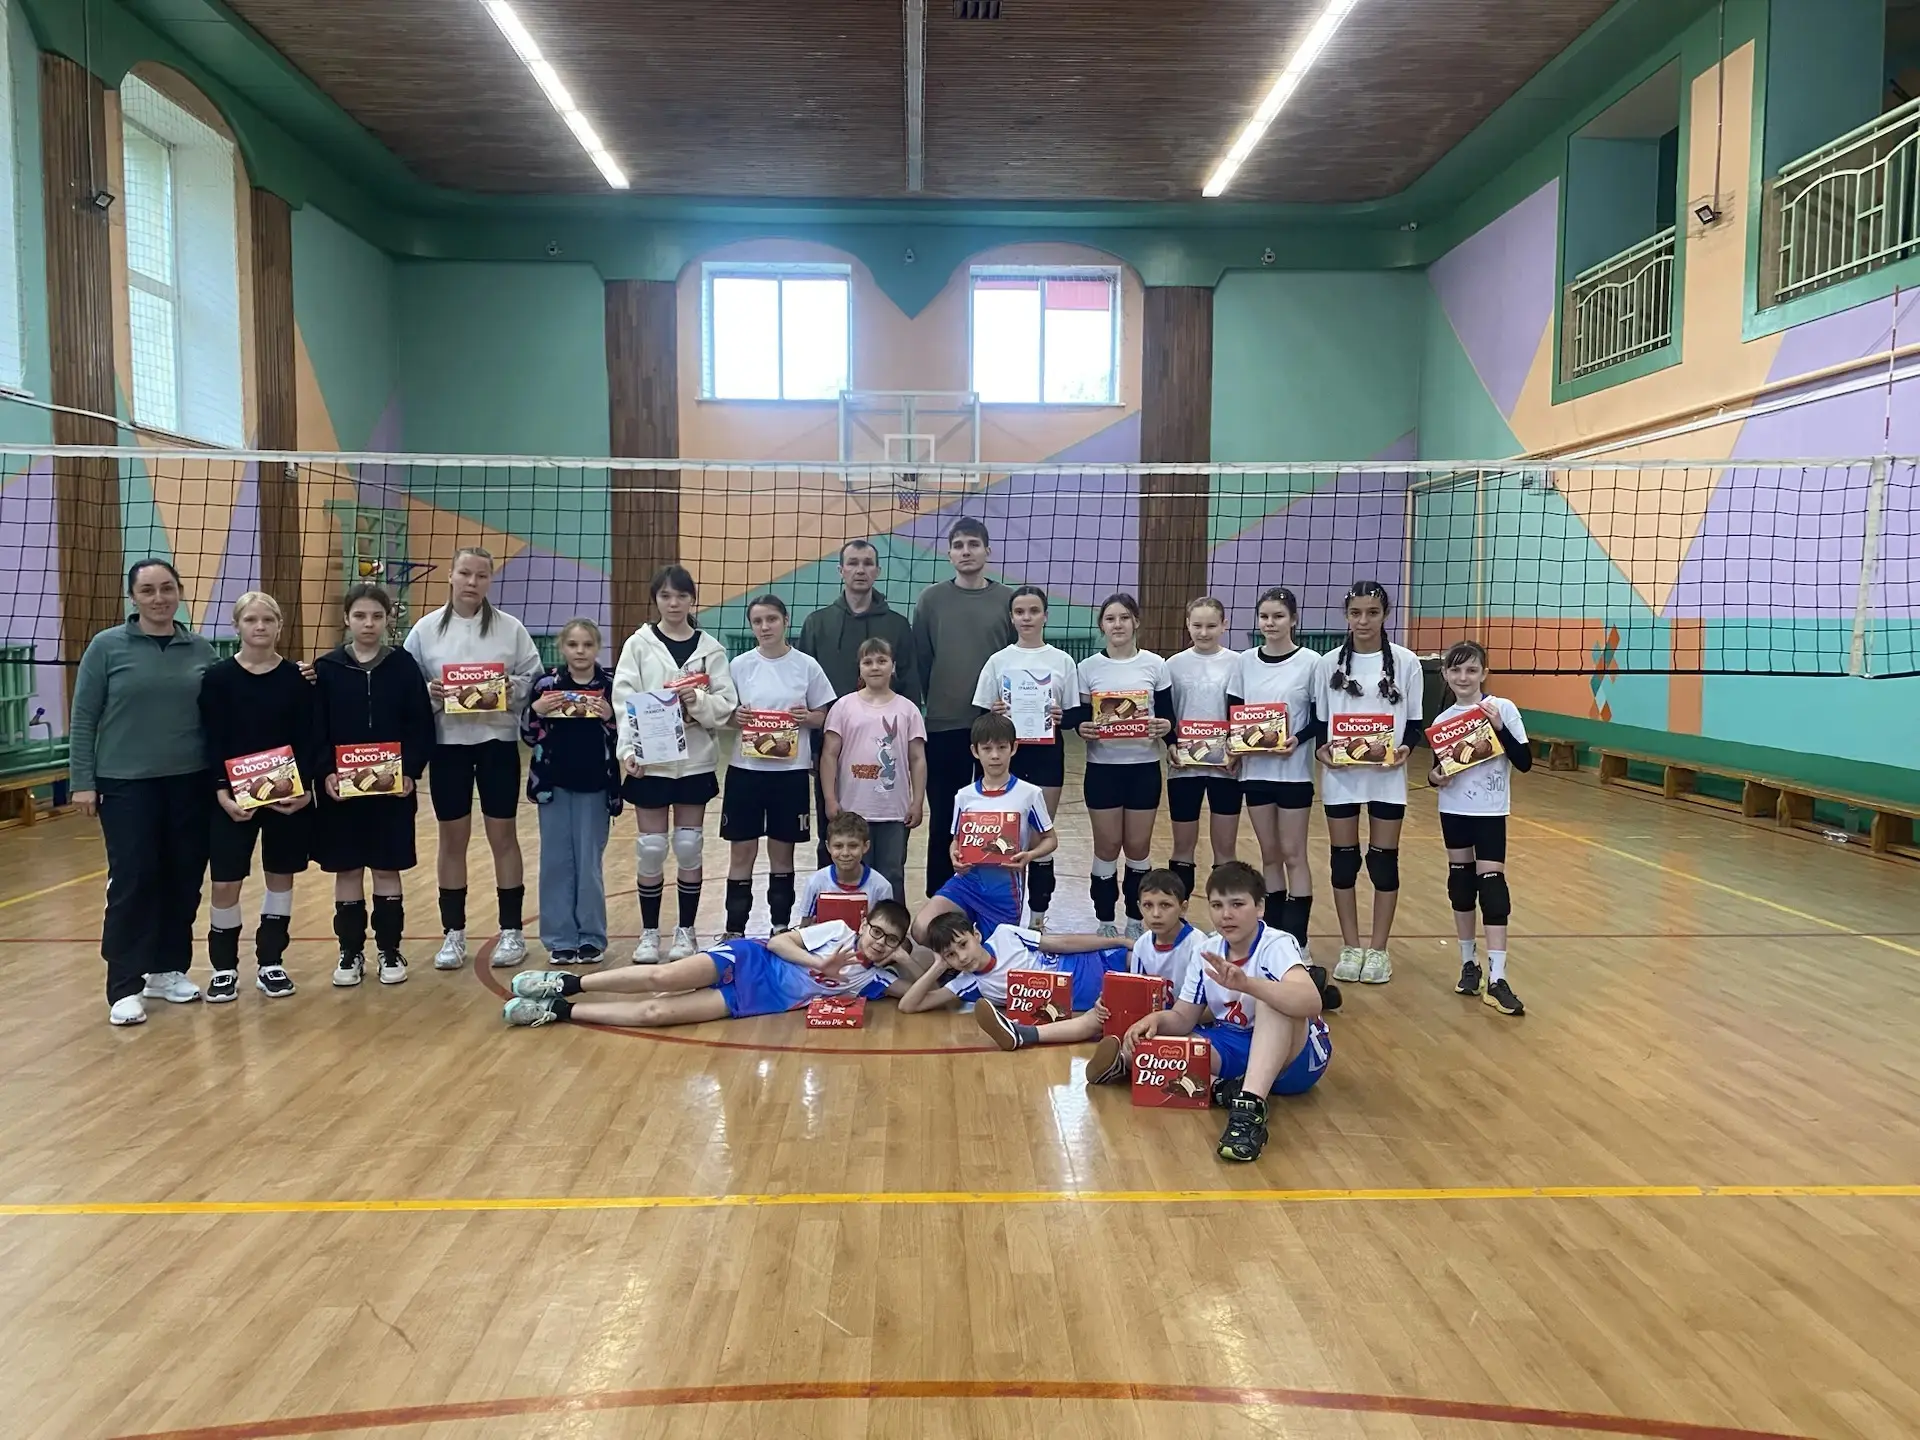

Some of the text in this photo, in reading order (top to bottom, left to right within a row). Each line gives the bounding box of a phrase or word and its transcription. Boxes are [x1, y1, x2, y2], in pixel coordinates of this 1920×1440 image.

[447, 670, 499, 681] Choco-Pie
[1233, 709, 1280, 720] Choco-Pie
[1181, 726, 1227, 735] Choco-Pie
[1336, 722, 1389, 732] Choco-Pie
[1432, 718, 1482, 744] Choco-Pie
[341, 751, 396, 764] Choco-Pie
[232, 755, 288, 776] Choco-Pie
[961, 822, 1001, 834] Choco
[961, 834, 984, 847] Pie
[1009, 983, 1051, 999] Choco
[1009, 997, 1033, 1011] Pie
[810, 1018, 844, 1026] Choco Pie
[1135, 1053, 1187, 1070] Choco
[1135, 1069, 1165, 1087] Pie
